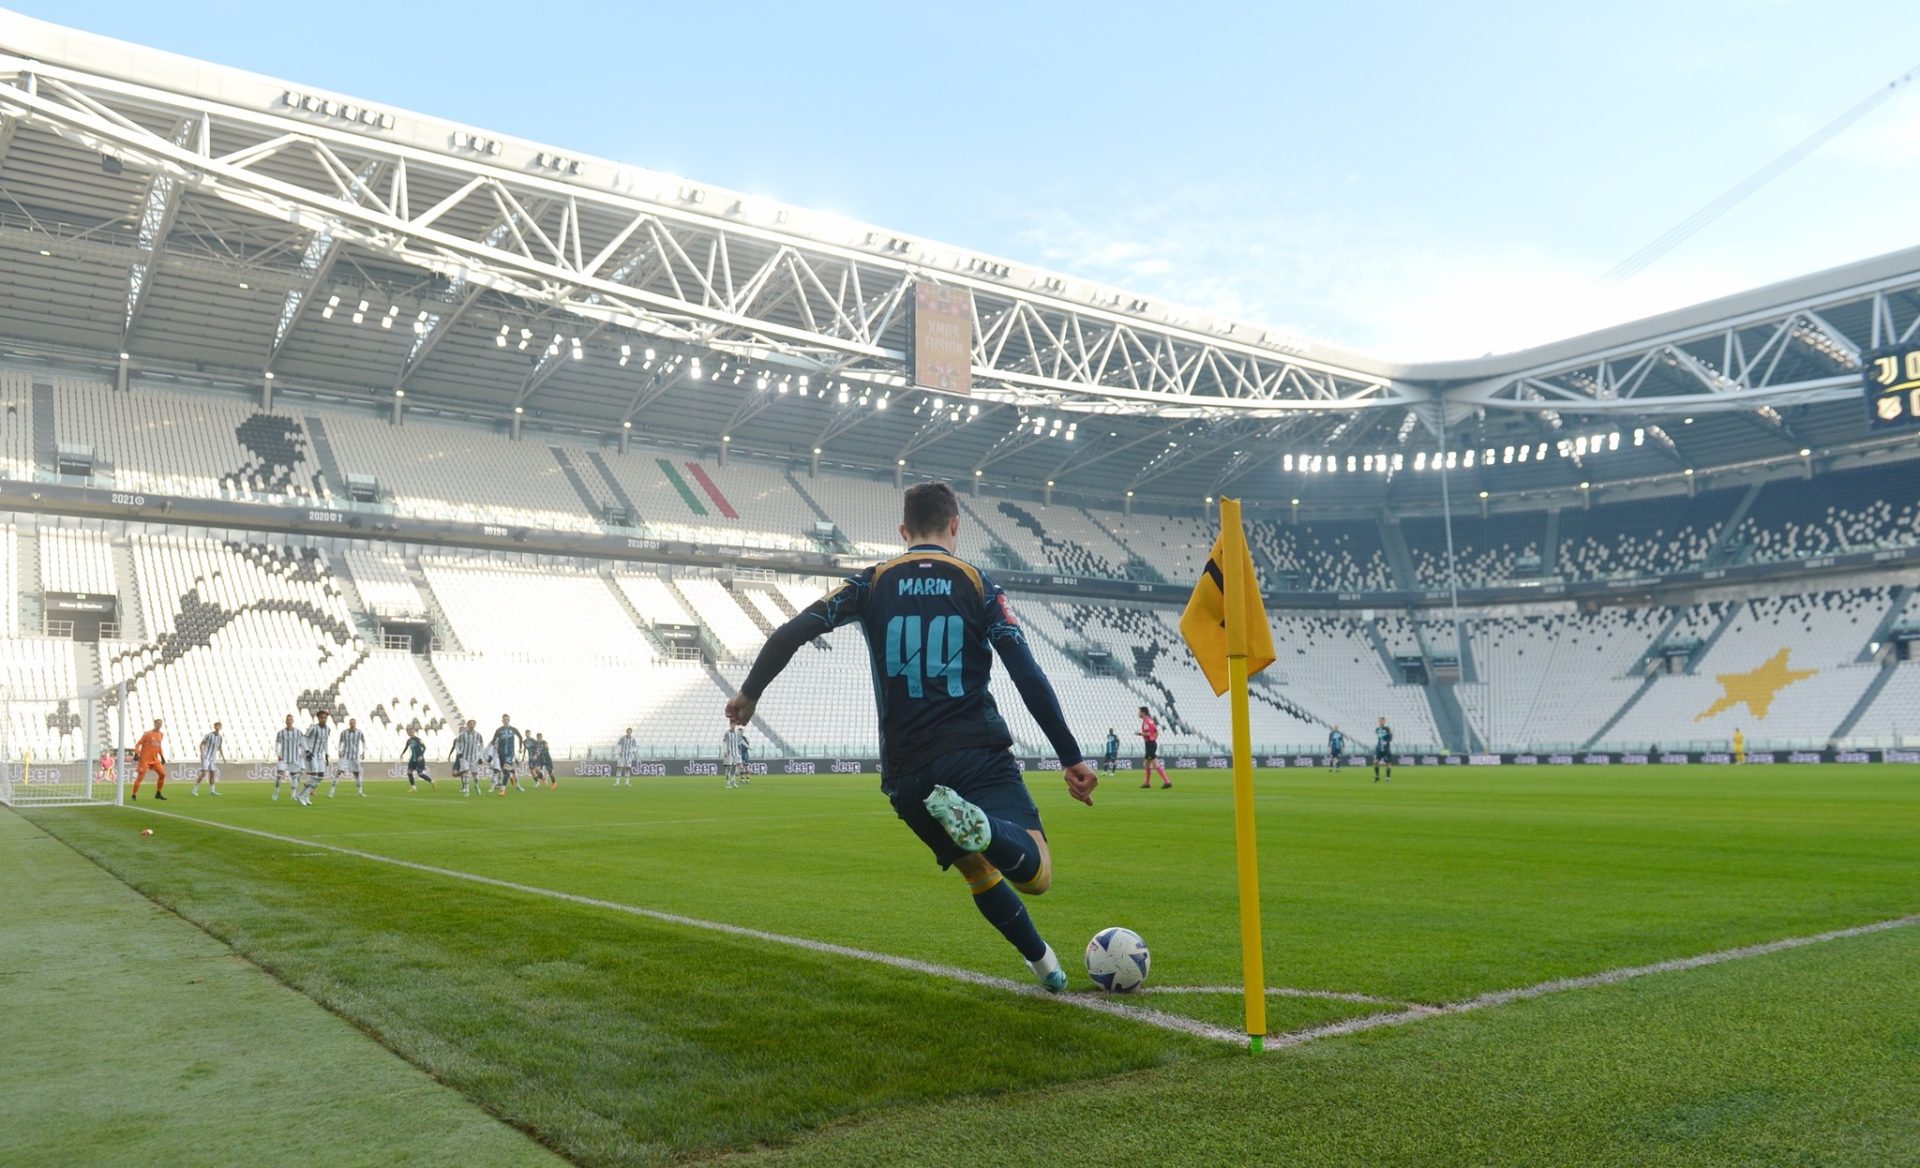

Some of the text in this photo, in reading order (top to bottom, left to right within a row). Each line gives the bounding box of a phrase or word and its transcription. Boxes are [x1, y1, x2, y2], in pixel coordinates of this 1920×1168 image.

[112, 493, 134, 504] 2021
[309, 511, 330, 521] 2020
[898, 577, 952, 597] MARIN
[886, 615, 966, 698] 44
[575, 760, 612, 778] Jeep
[631, 760, 666, 777] Jeep
[684, 760, 718, 776] Jeep
[784, 759, 816, 775] Jeep
[831, 759, 862, 774] Jeep
[1037, 756, 1062, 772] Jeep
